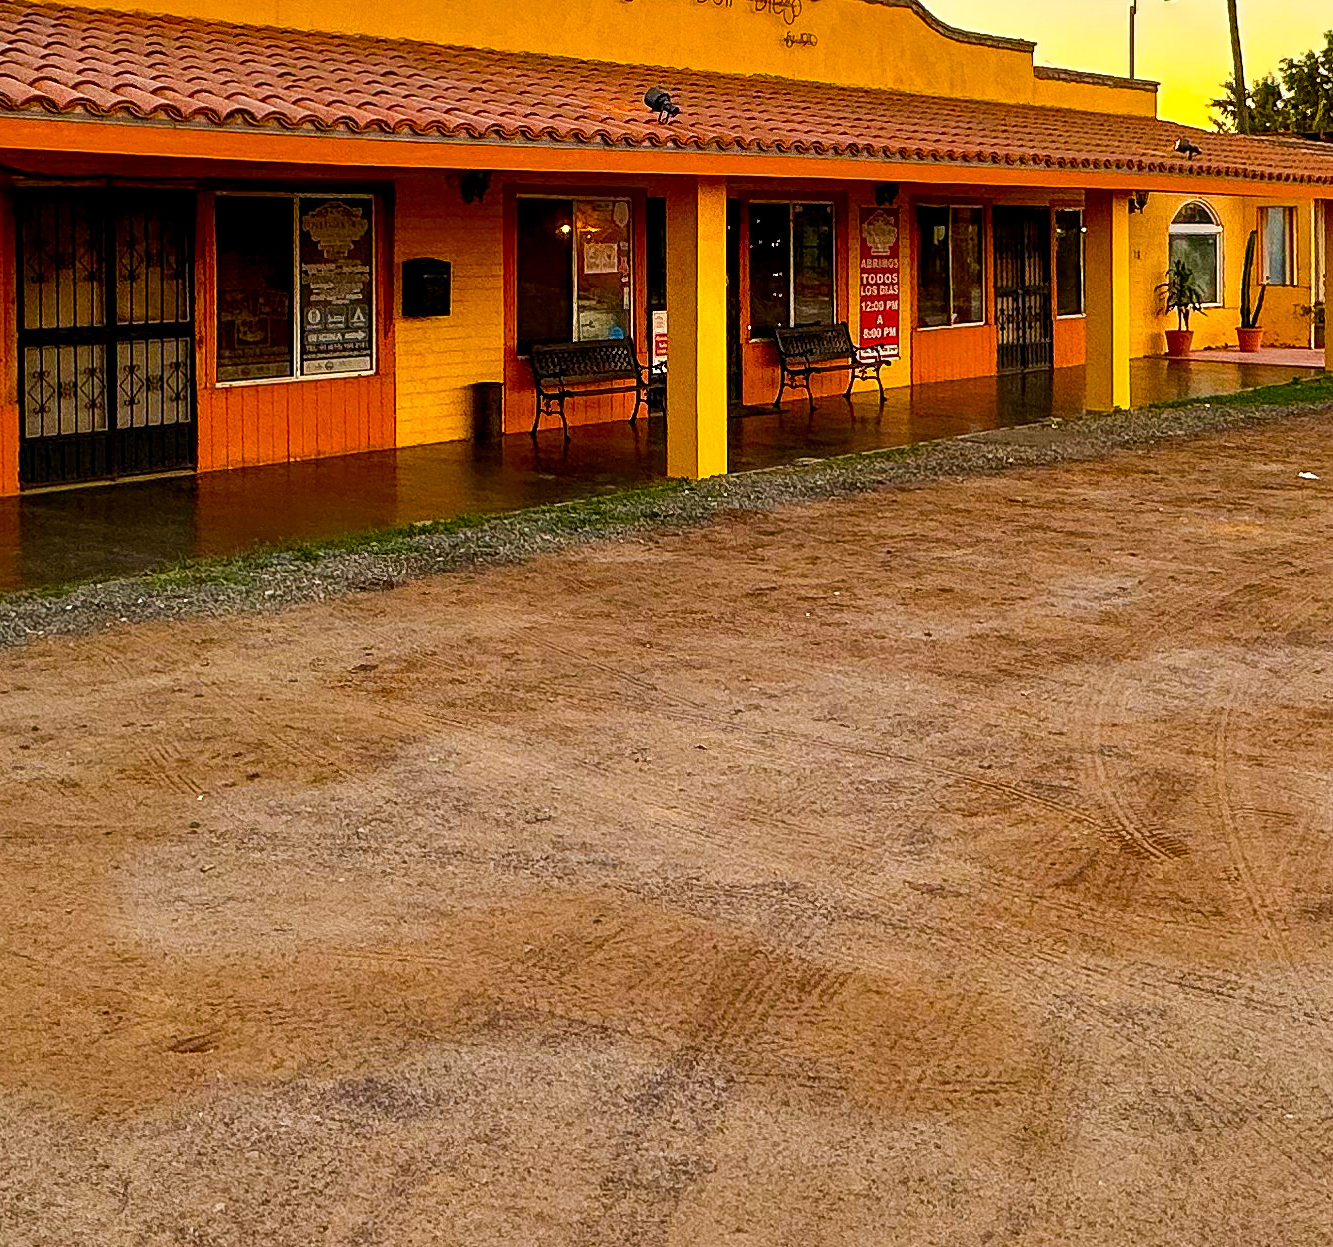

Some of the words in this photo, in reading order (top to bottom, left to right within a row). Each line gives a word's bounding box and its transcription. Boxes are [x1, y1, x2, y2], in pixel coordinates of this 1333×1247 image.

[861, 273, 898, 285] TODOS
[860, 285, 878, 296] LOS
[861, 300, 885, 312] 12:00
[886, 299, 899, 311] PM
[876, 314, 884, 325] A
[883, 326, 897, 338] PM
